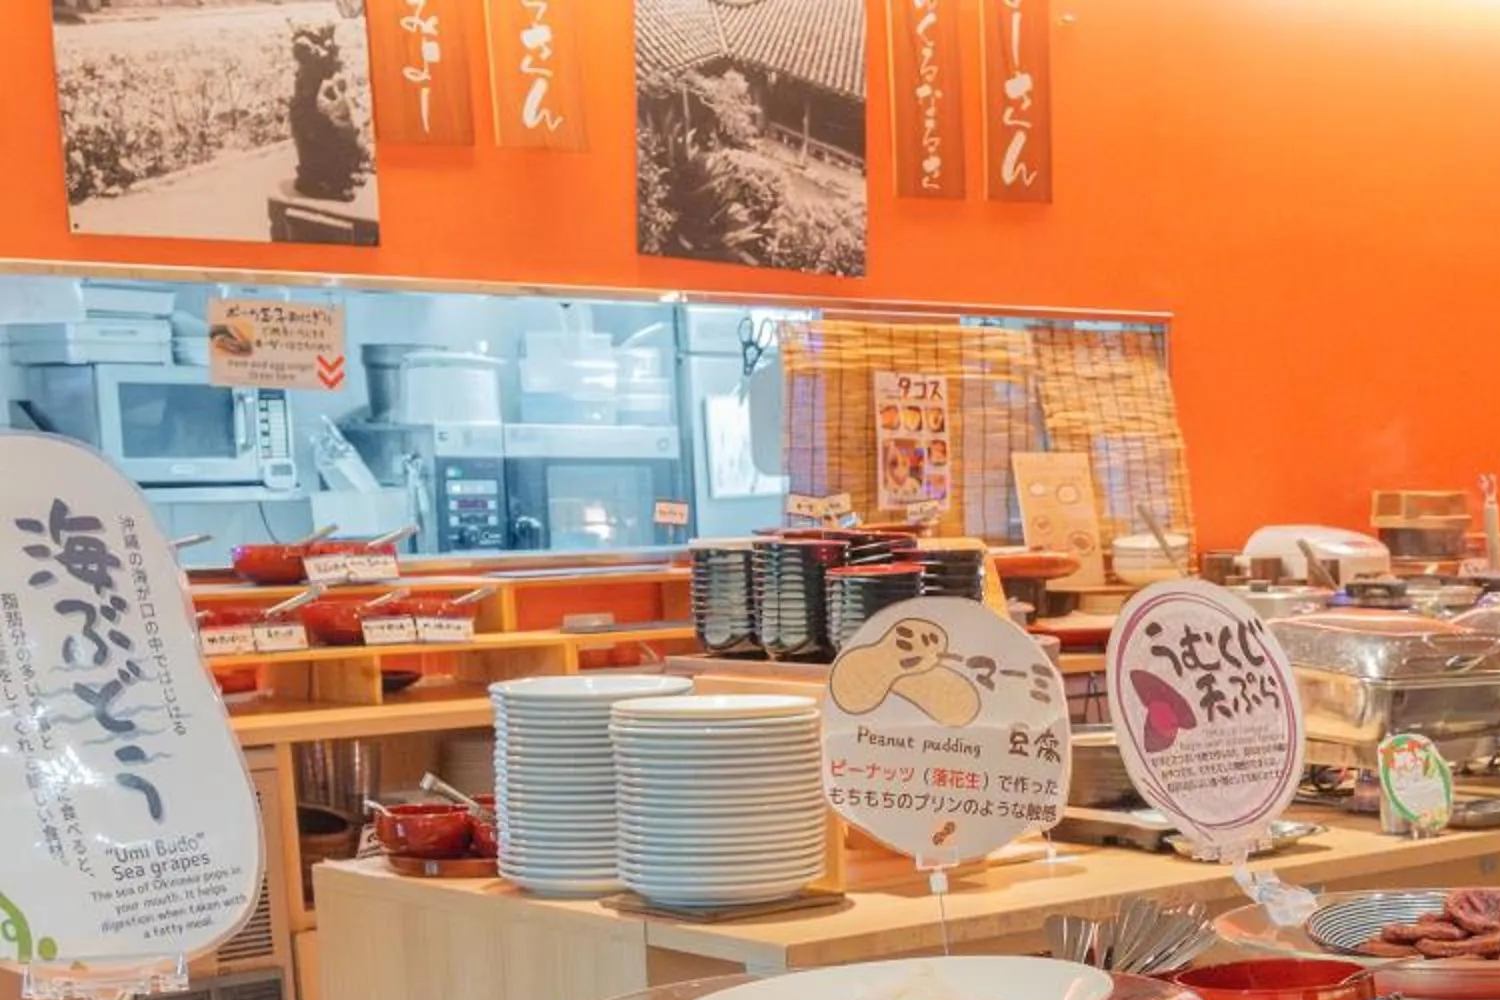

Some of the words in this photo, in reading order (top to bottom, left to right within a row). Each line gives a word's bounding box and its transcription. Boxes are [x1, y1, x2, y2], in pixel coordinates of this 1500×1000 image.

[898, 377, 943, 400] タコス
[1145, 619, 1265, 678] うむくじ
[1195, 671, 1281, 722] 天ぷら
[856, 726, 916, 750] Peanut
[921, 738, 982, 759] pudding
[1008, 721, 1062, 764] 豆腐
[112, 864, 146, 881] Sea
[150, 852, 211, 878] grapes
